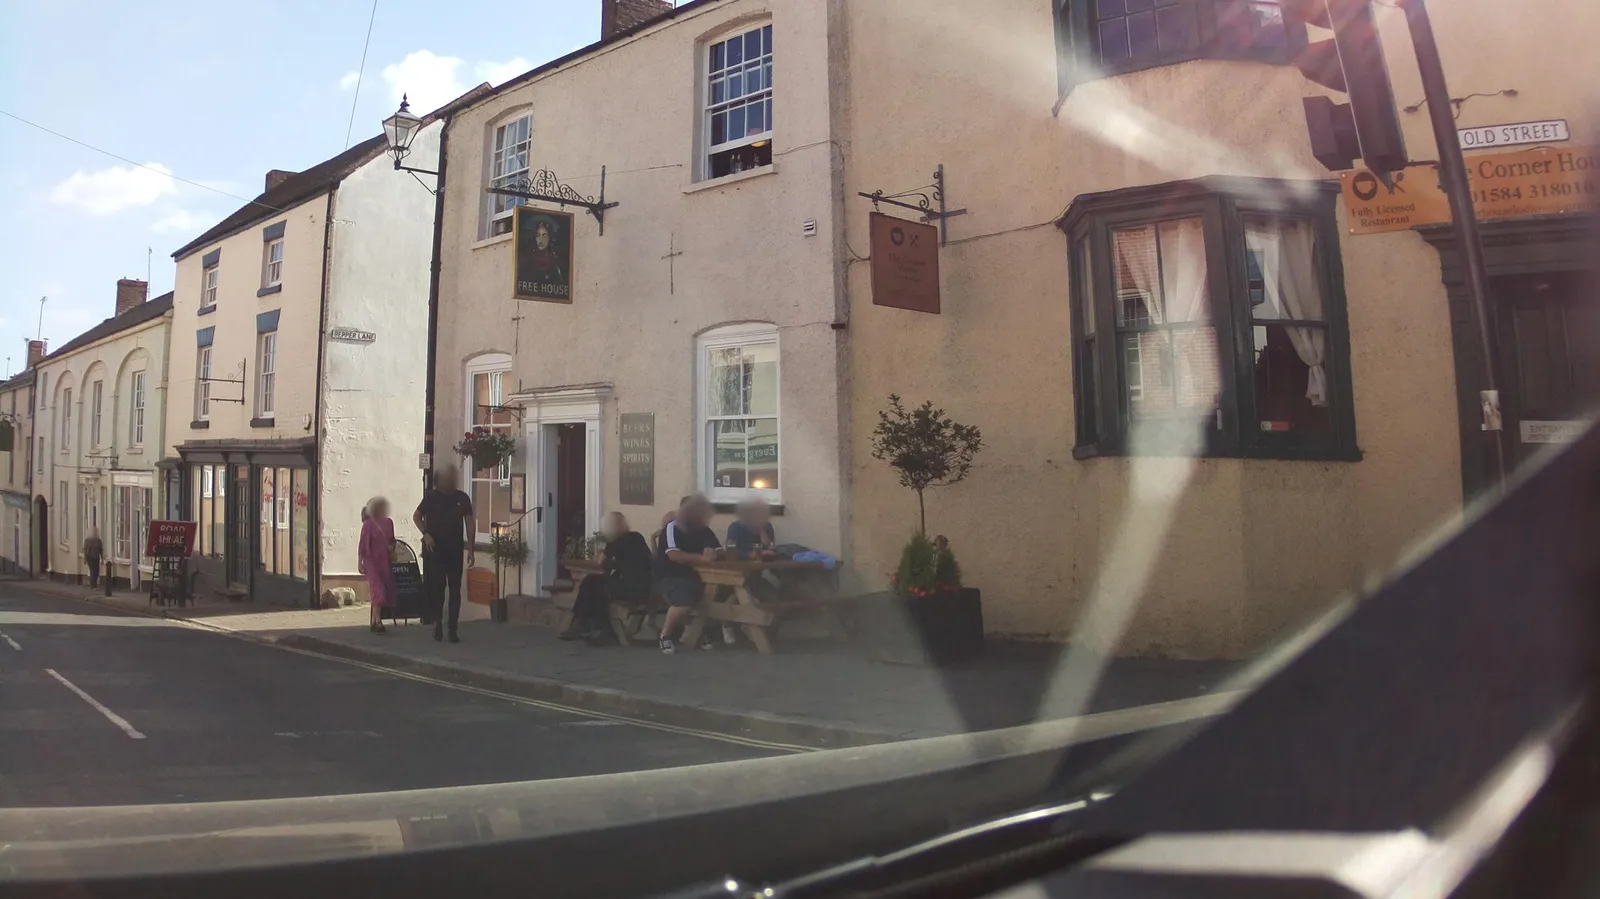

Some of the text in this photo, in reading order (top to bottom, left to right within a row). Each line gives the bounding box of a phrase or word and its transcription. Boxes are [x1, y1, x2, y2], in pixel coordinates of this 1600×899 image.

[1464, 123, 1560, 146] OLD STREET
[1478, 160, 1552, 179] Corner
[1351, 202, 1415, 218] Fully Licensed
[1361, 215, 1410, 227] Restaurant
[518, 280, 569, 296] FREE HOUSE
[334, 330, 357, 339] PEPPER
[623, 423, 650, 433] BEERS
[622, 438, 650, 448] WINES
[622, 453, 650, 463] SPIRITS
[160, 525, 185, 533] ROAD
